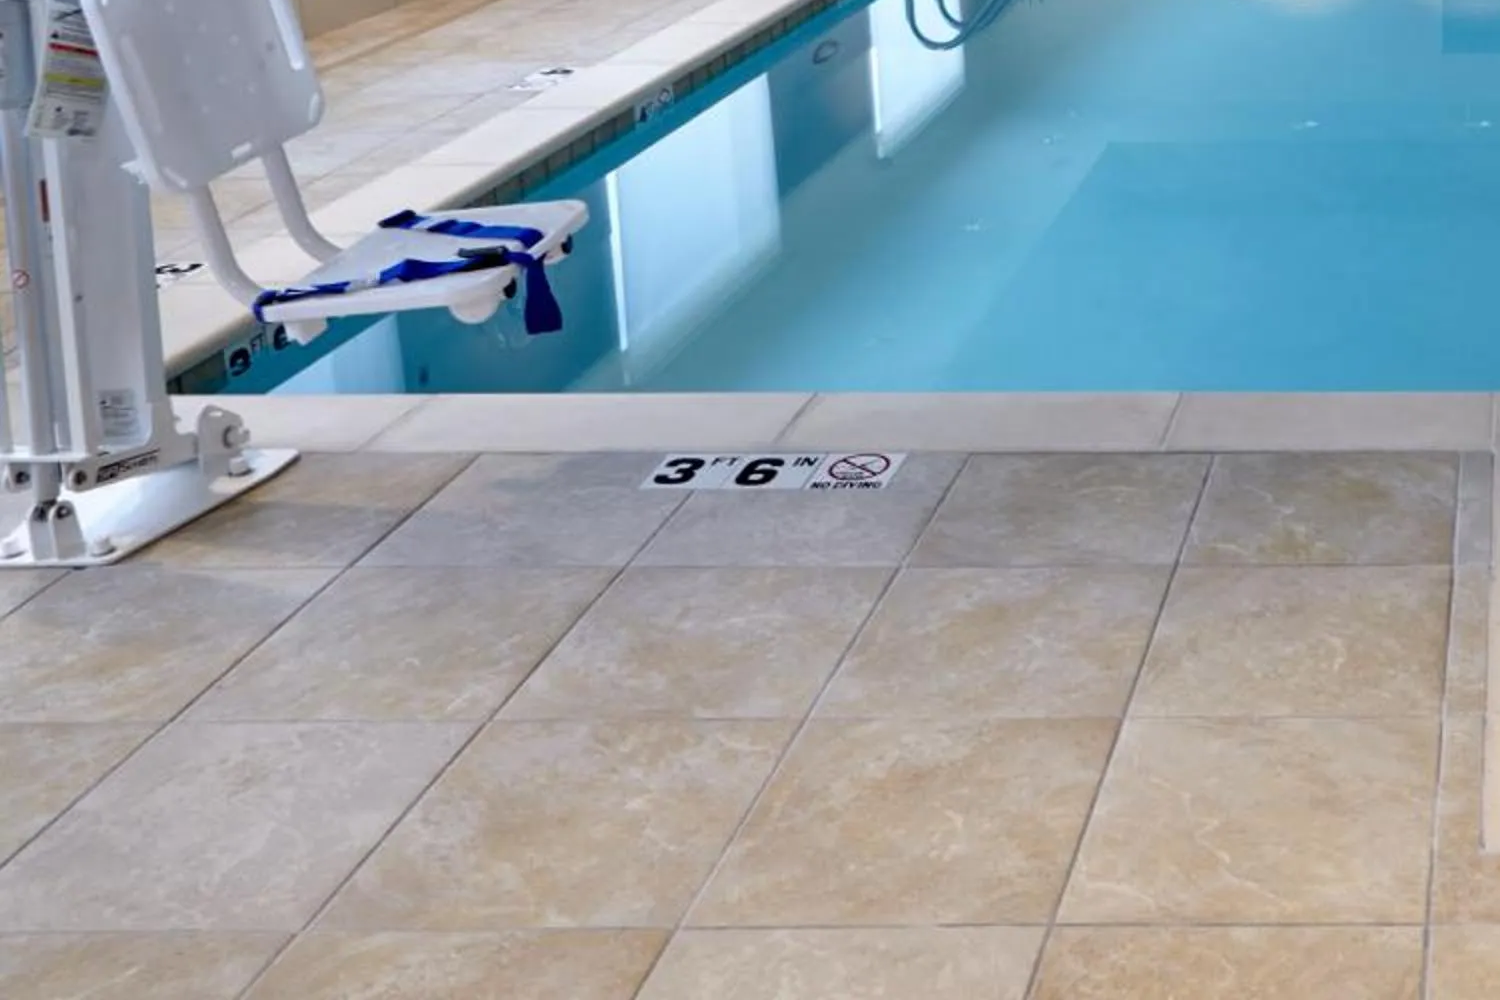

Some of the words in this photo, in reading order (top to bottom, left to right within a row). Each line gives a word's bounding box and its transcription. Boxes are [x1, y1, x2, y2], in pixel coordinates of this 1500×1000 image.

[653, 457, 706, 484] 3
[711, 456, 740, 467] FT
[734, 457, 785, 485] 6
[792, 456, 818, 467] IN
[810, 481, 831, 489] NO
[832, 481, 882, 489] DIVING
